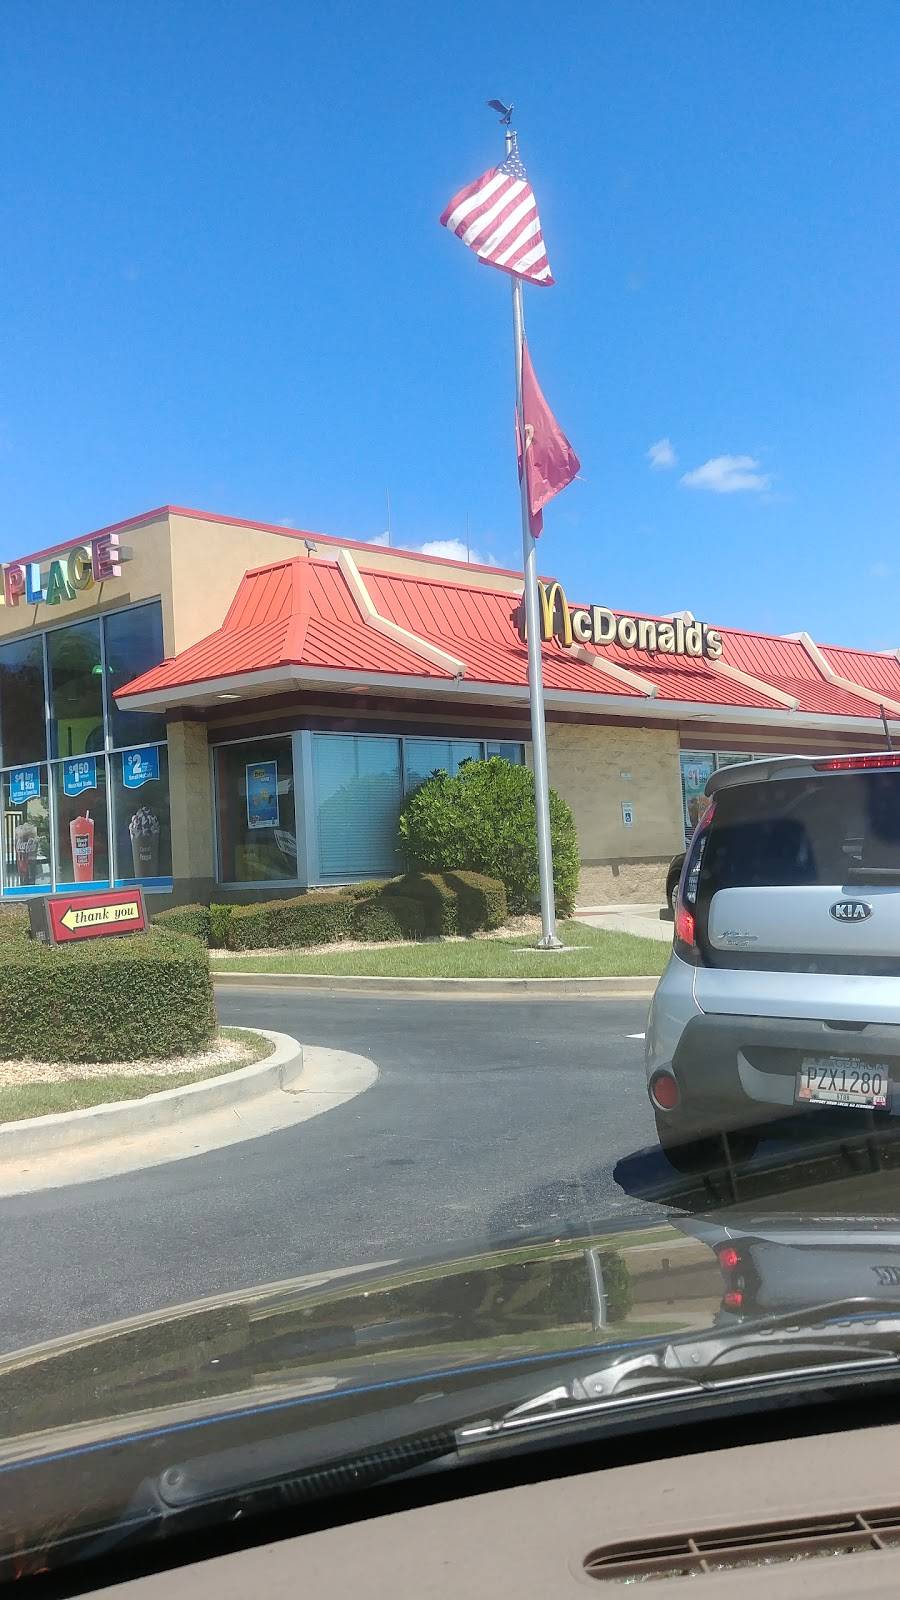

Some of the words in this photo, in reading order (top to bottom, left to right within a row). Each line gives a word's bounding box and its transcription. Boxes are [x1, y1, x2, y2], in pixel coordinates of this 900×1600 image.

[0, 533, 121, 607] PLACE
[524, 580, 723, 660] McDonald's
[127, 753, 142, 774] $2
[75, 908, 109, 924] thank
[114, 907, 134, 920] you
[835, 904, 866, 918] KIA
[807, 1066, 882, 1095] PZX1280
